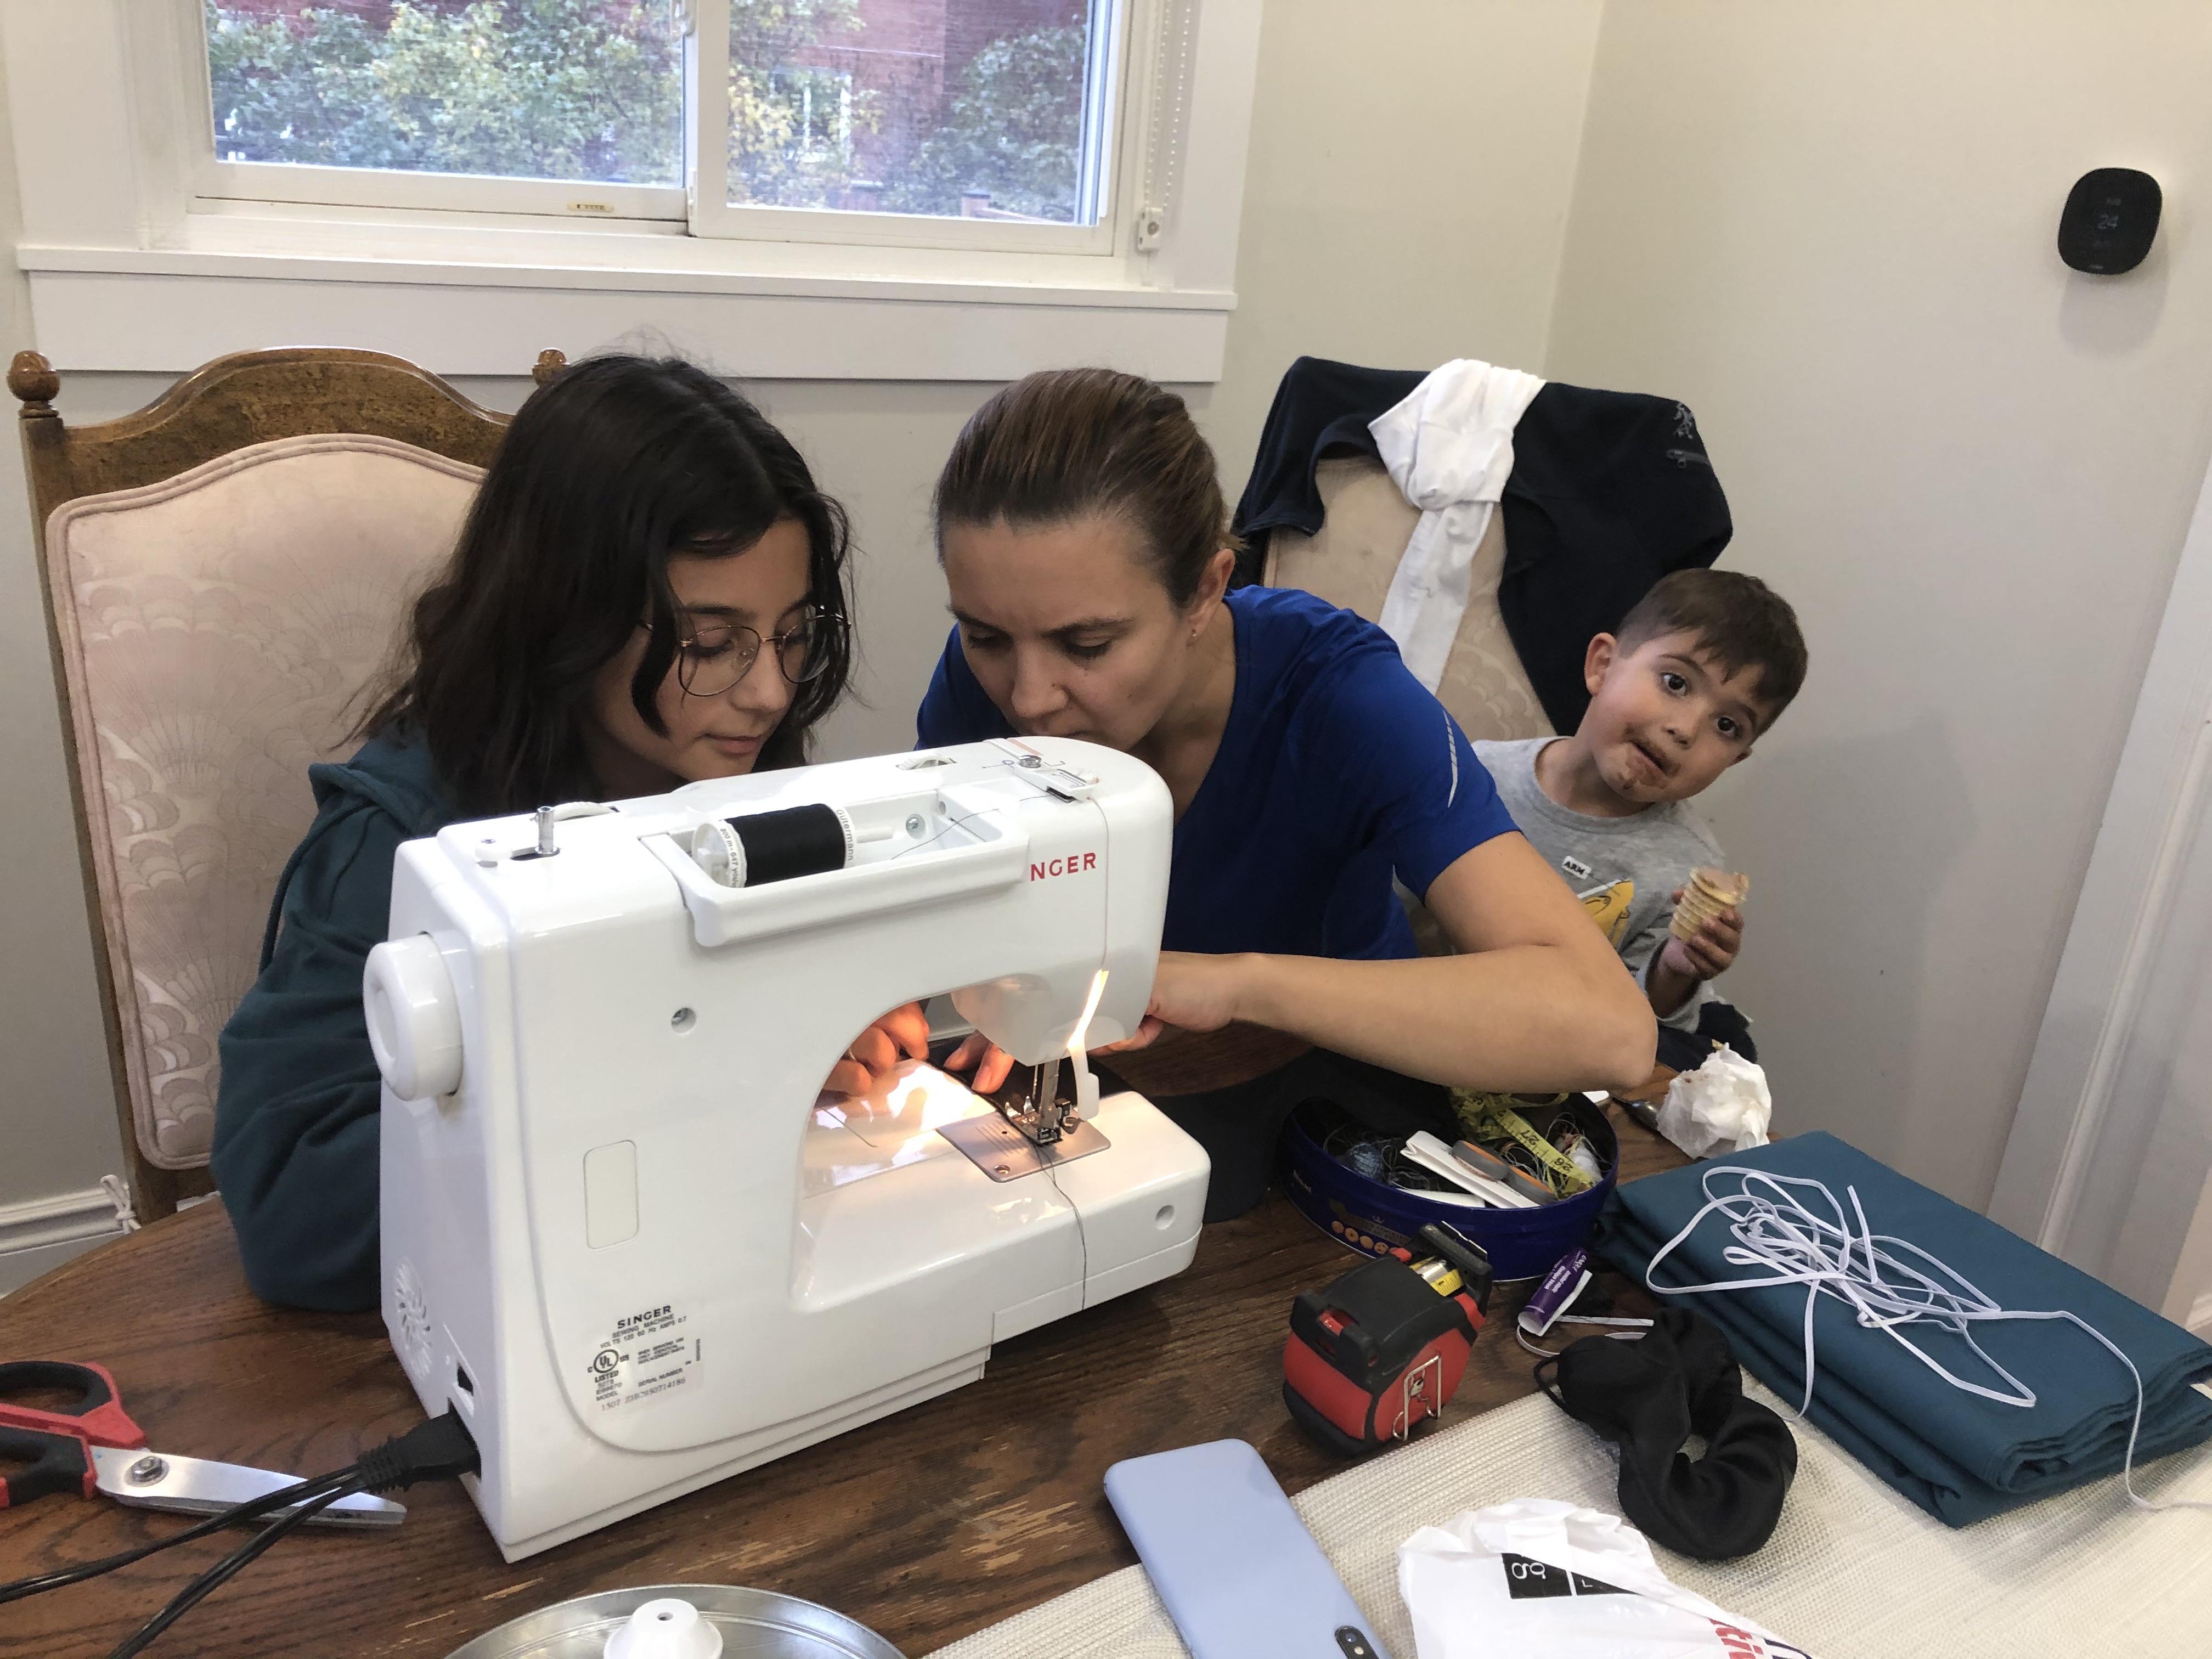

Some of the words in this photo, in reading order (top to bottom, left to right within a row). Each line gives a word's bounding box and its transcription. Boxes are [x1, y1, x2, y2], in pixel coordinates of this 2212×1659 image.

[1030, 853, 1096, 882] NGER
[1520, 1130, 1540, 1146] 27
[1554, 1157, 1573, 1173] 26
[617, 1305, 671, 1329] SINGER
[660, 1320, 675, 1329] AMPS
[612, 1325, 639, 1339] SEWING
[644, 1313, 674, 1328] MACHINE
[595, 1370, 619, 1383] LISTED
[638, 1377, 657, 1387] SERIAL
[659, 1368, 683, 1379] NUMBER
[596, 1391, 618, 1401] MODEL
